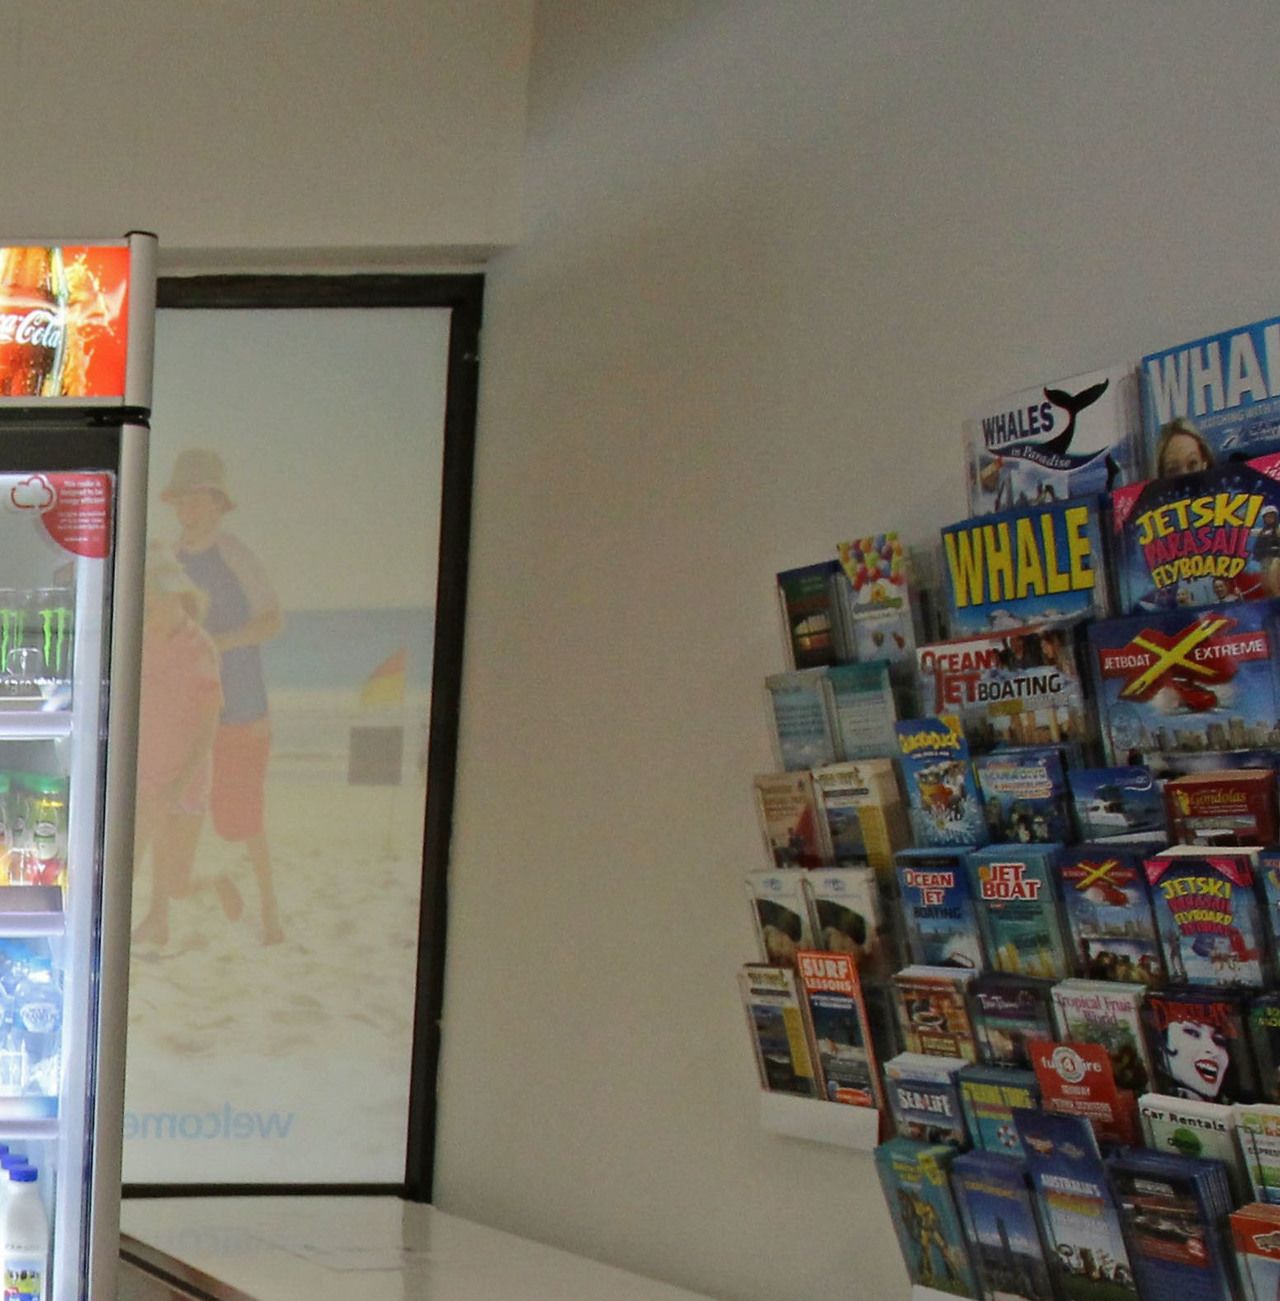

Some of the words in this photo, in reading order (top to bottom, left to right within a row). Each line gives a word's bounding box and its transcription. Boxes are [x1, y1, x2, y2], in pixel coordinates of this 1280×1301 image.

[982, 402, 1055, 446] WHALES
[1023, 446, 1072, 469] Paradise
[1136, 494, 1264, 545] JETSKI
[944, 506, 1096, 609] WHALE
[1152, 556, 1245, 590] FLYBOARD
[1104, 653, 1151, 670] JETBOAT
[1194, 638, 1264, 661] EXTREME
[933, 671, 982, 715] JET
[978, 673, 1062, 702] BOATING
[904, 868, 955, 888] OCEAN
[990, 863, 1025, 882] JET
[921, 888, 945, 907] JET
[981, 881, 1041, 901] BOAT
[1160, 876, 1232, 900] JETSKI
[914, 906, 964, 919] BOATING
[803, 958, 848, 979] SURF
[806, 977, 852, 992] LESSONS
[897, 1088, 923, 1109] SEA
[928, 1094, 953, 1117] LIFE
[1142, 1108, 1164, 1120] Car
[1169, 1112, 1227, 1132] Rentals
